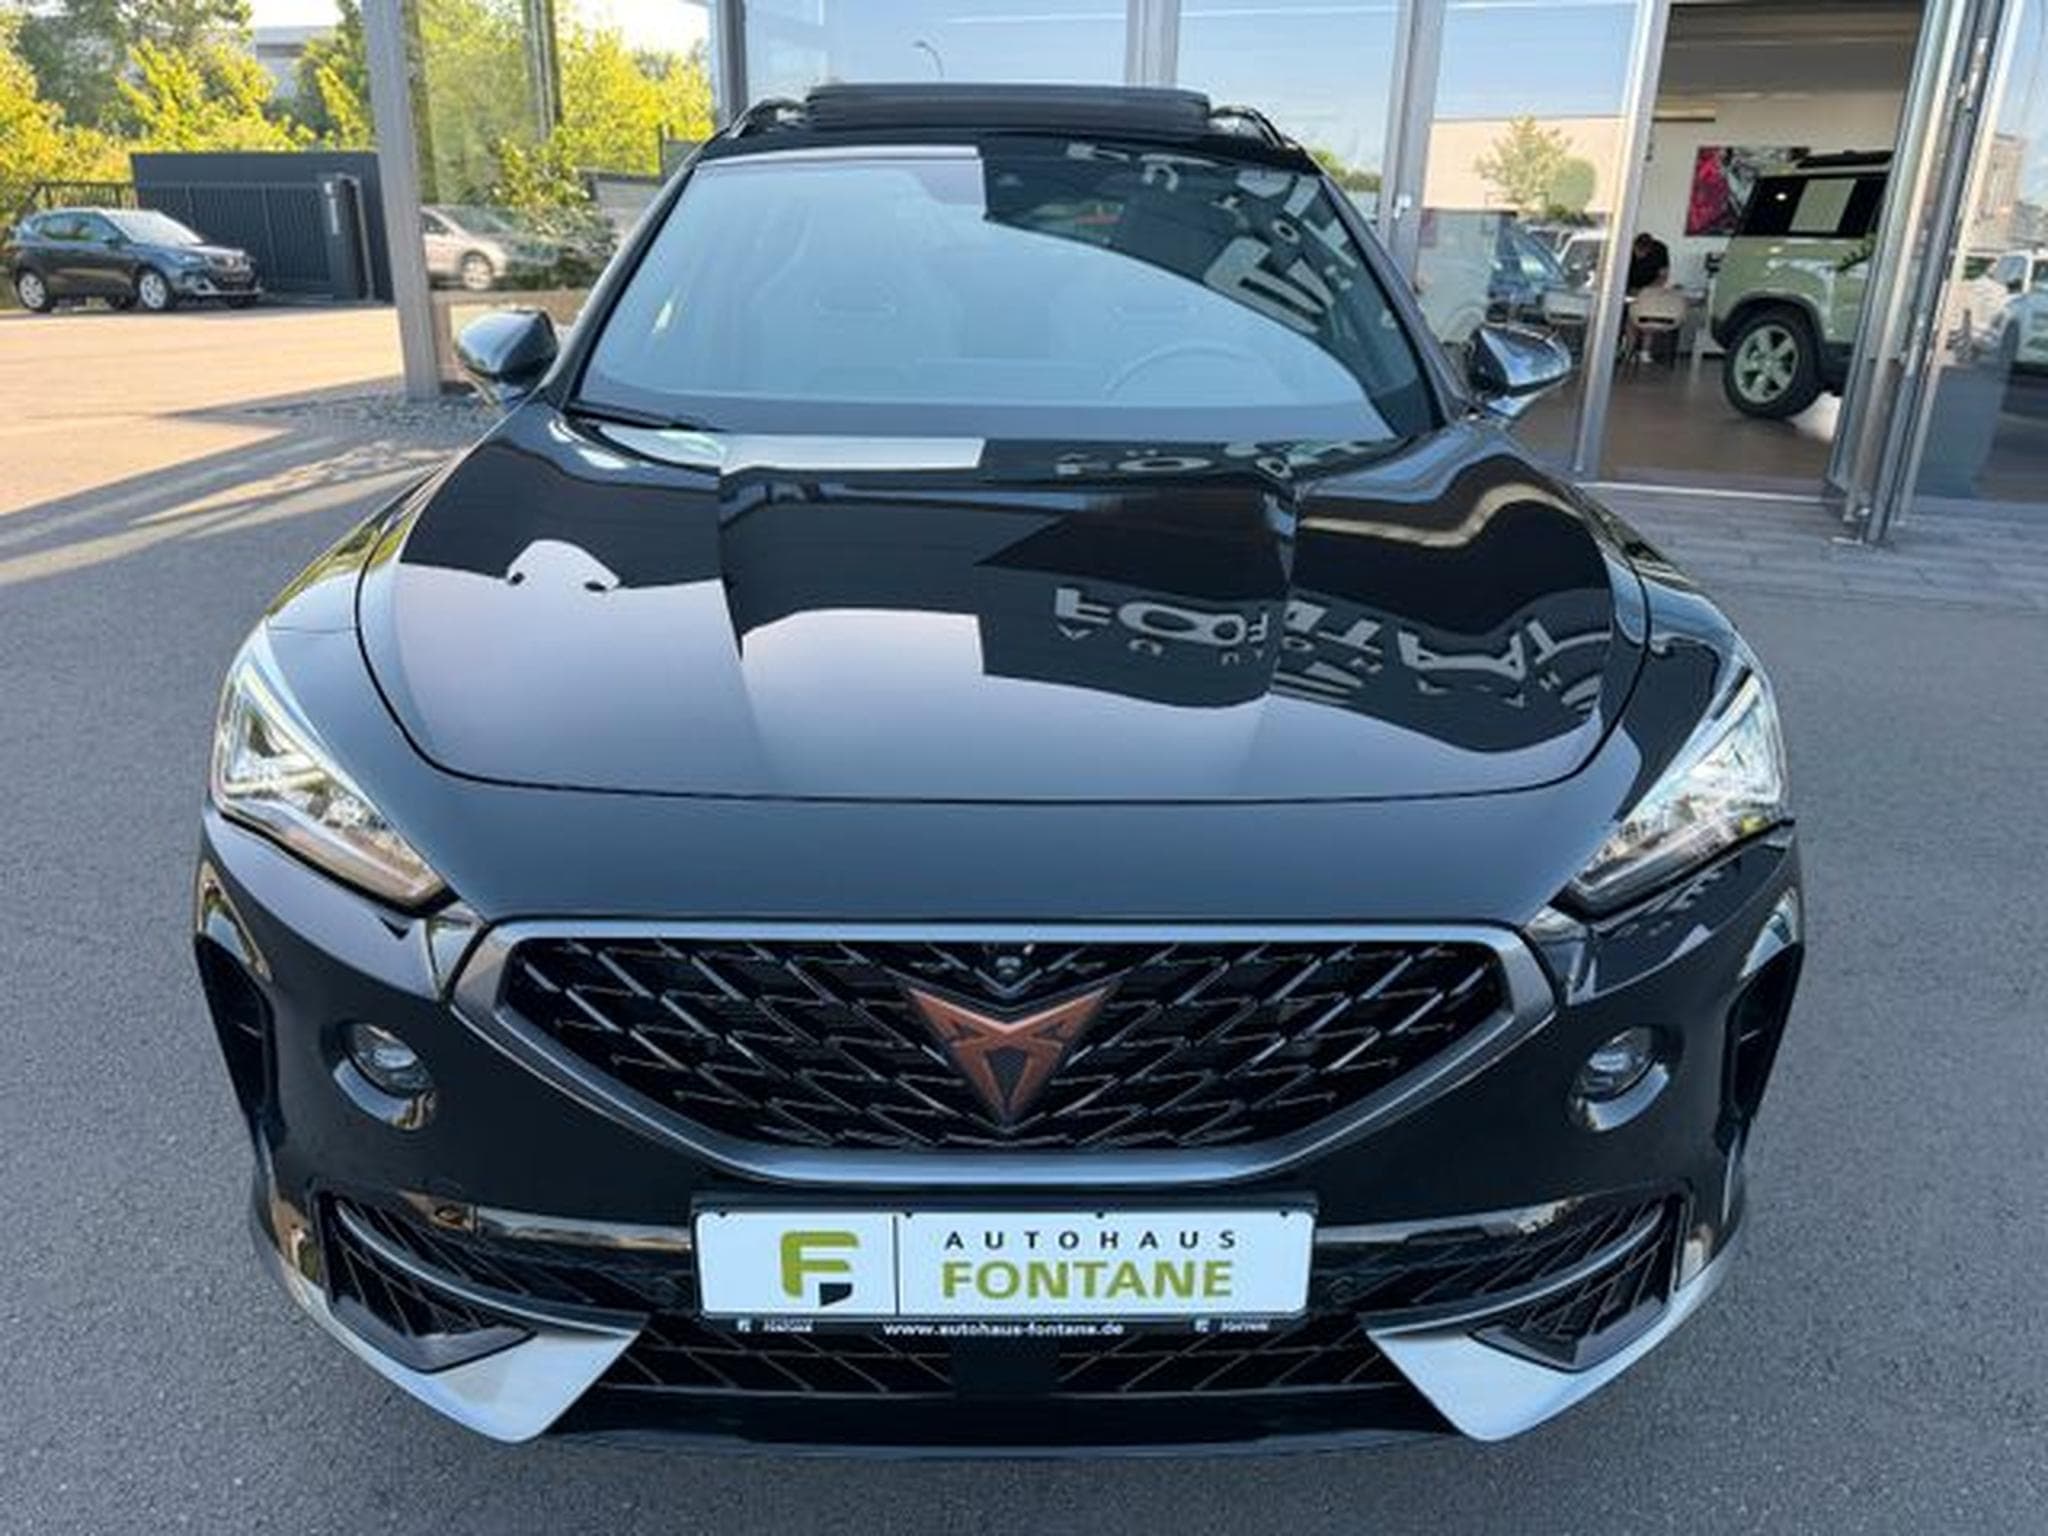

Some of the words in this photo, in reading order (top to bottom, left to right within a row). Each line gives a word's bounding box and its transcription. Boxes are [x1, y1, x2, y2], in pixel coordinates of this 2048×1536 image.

[945, 1230, 1236, 1251] AUTOHAUS
[942, 1260, 1233, 1299] FONTANE
[883, 1320, 1124, 1337] www.autohaus-fontane.de
